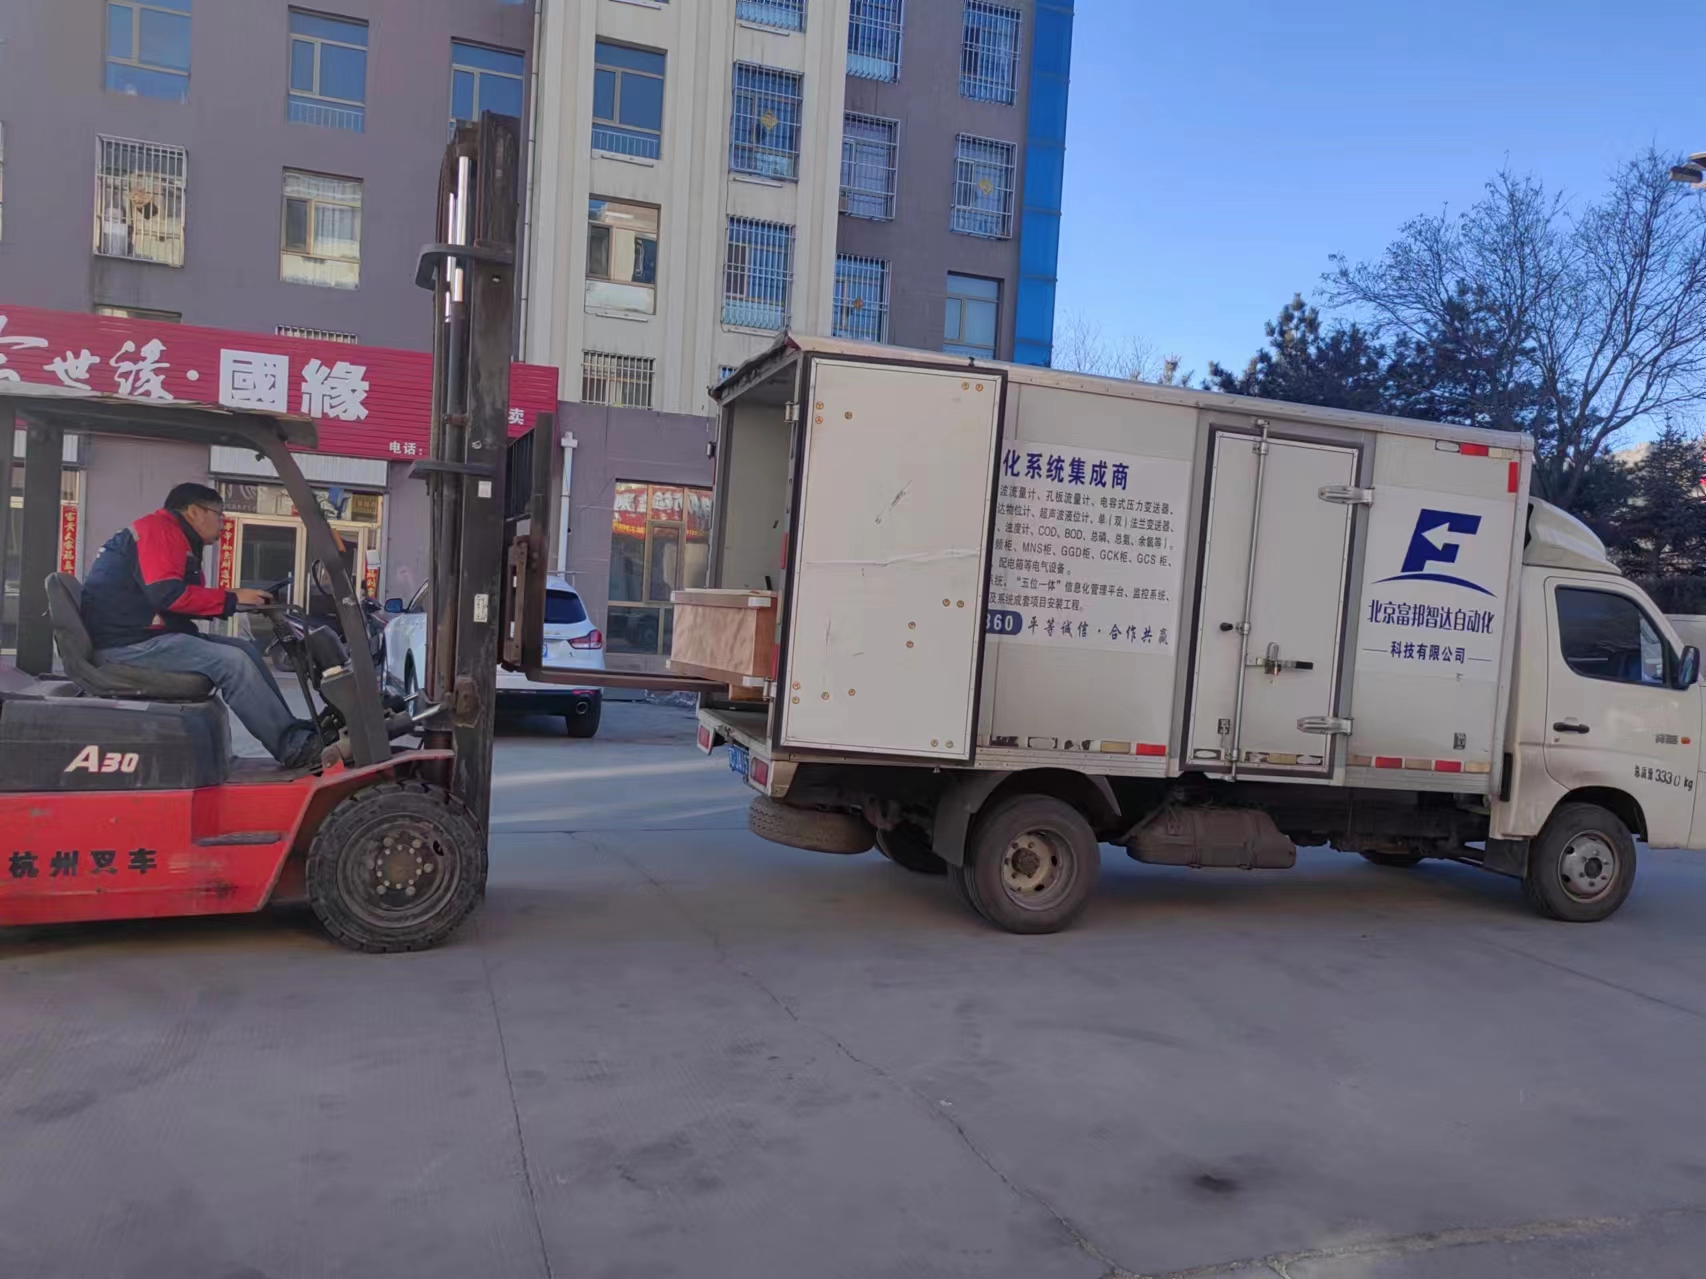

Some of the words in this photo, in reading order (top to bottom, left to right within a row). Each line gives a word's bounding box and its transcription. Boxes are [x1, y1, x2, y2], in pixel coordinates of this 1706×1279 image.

[1002, 448, 1130, 491] 化系统集成商
[1366, 599, 1496, 635] 北京富邦智达自动化
[1390, 641, 1466, 664] 科技有限公司
[64, 744, 139, 774] A30
[8, 847, 157, 879] 杭州叉车
